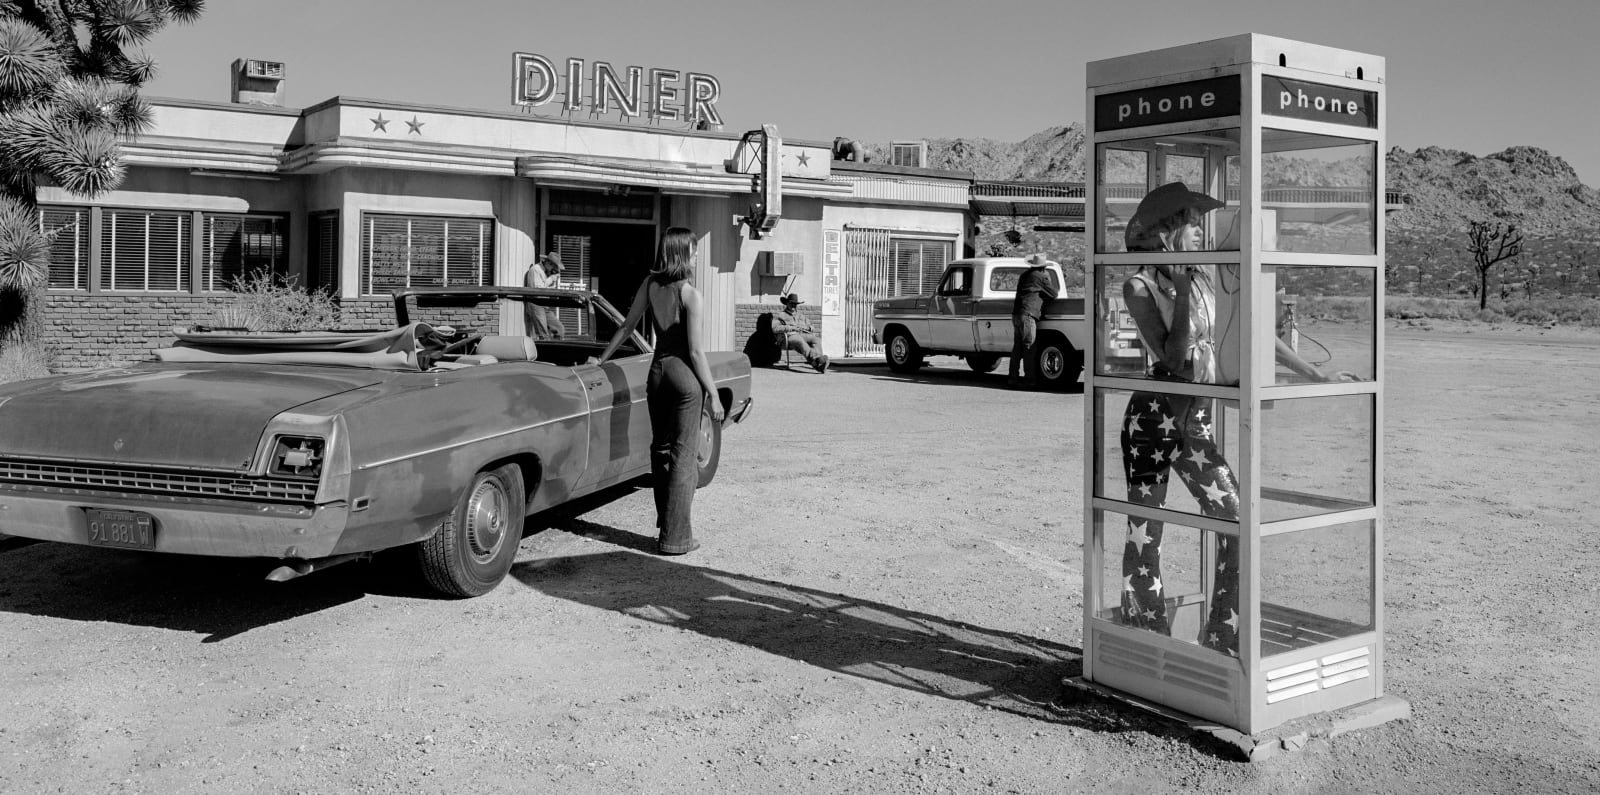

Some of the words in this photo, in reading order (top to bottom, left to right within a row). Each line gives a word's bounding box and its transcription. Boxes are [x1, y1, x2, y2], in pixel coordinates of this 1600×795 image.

[511, 51, 724, 125] DINER
[1280, 89, 1358, 115] phone
[1118, 91, 1216, 121] phone
[825, 231, 839, 286] DELTA
[91, 521, 109, 541] 91
[111, 523, 137, 544] 881
[138, 525, 149, 545] W
